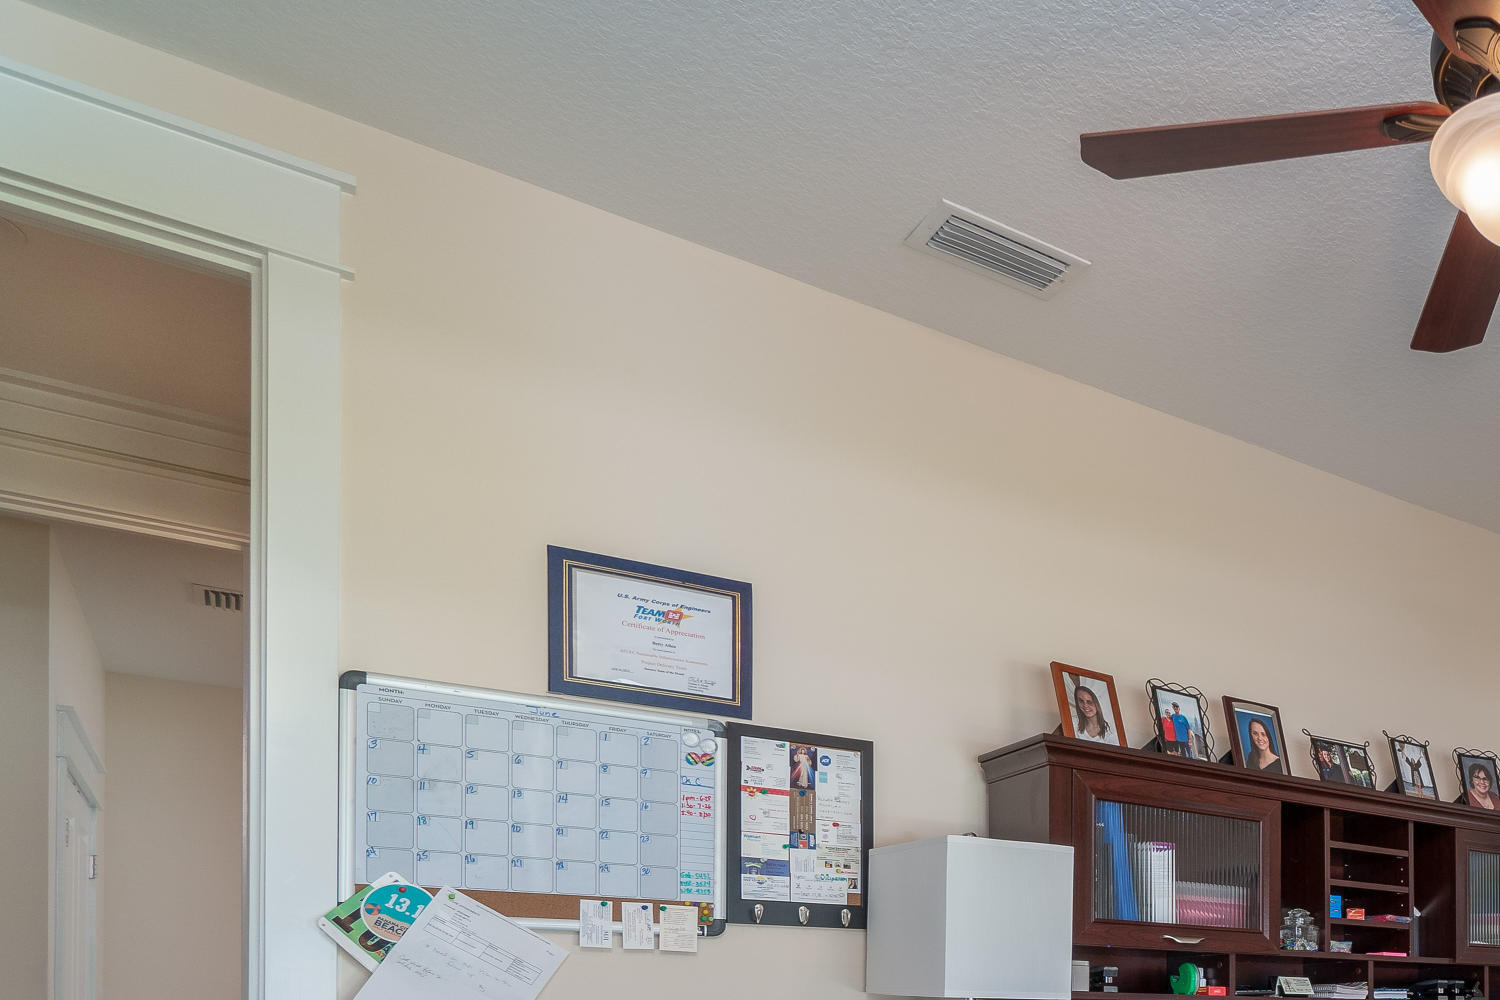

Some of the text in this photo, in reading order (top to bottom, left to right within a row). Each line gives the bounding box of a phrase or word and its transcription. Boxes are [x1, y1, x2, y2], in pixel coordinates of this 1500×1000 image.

[632, 595, 649, 603] Army
[651, 599, 670, 607] Corps
[680, 604, 711, 614] Engineers
[636, 605, 665, 618] TEAM
[622, 620, 656, 632] Certificate
[666, 628, 705, 640] Appreciation
[378, 687, 404, 695] MONTH:
[378, 696, 403, 704] SUNDAY
[515, 714, 549, 723] WEDNESDAY
[561, 720, 589, 728] THURSDAY
[526, 705, 560, 718] June
[643, 735, 650, 746] 2
[368, 739, 378, 749] 3
[417, 744, 427, 755] 4
[466, 750, 475, 758] 5
[514, 755, 522, 764] 6
[558, 760, 564, 769] 7
[641, 769, 648, 777] 9
[367, 777, 377, 785] 10
[420, 781, 426, 790] 11
[466, 785, 477, 794] 12
[513, 789, 522, 798] 13
[558, 793, 568, 803] 14
[641, 802, 648, 810] 16
[367, 812, 377, 822] 17
[417, 816, 427, 825] 18
[465, 820, 474, 830] 19
[512, 824, 521, 833] 20
[556, 828, 564, 836] 21
[600, 831, 609, 839] 22
[366, 846, 650, 876] 24 25 26 27 28 29 30
[384, 893, 425, 919] 13.1
[377, 916, 399, 928] PANAMA
